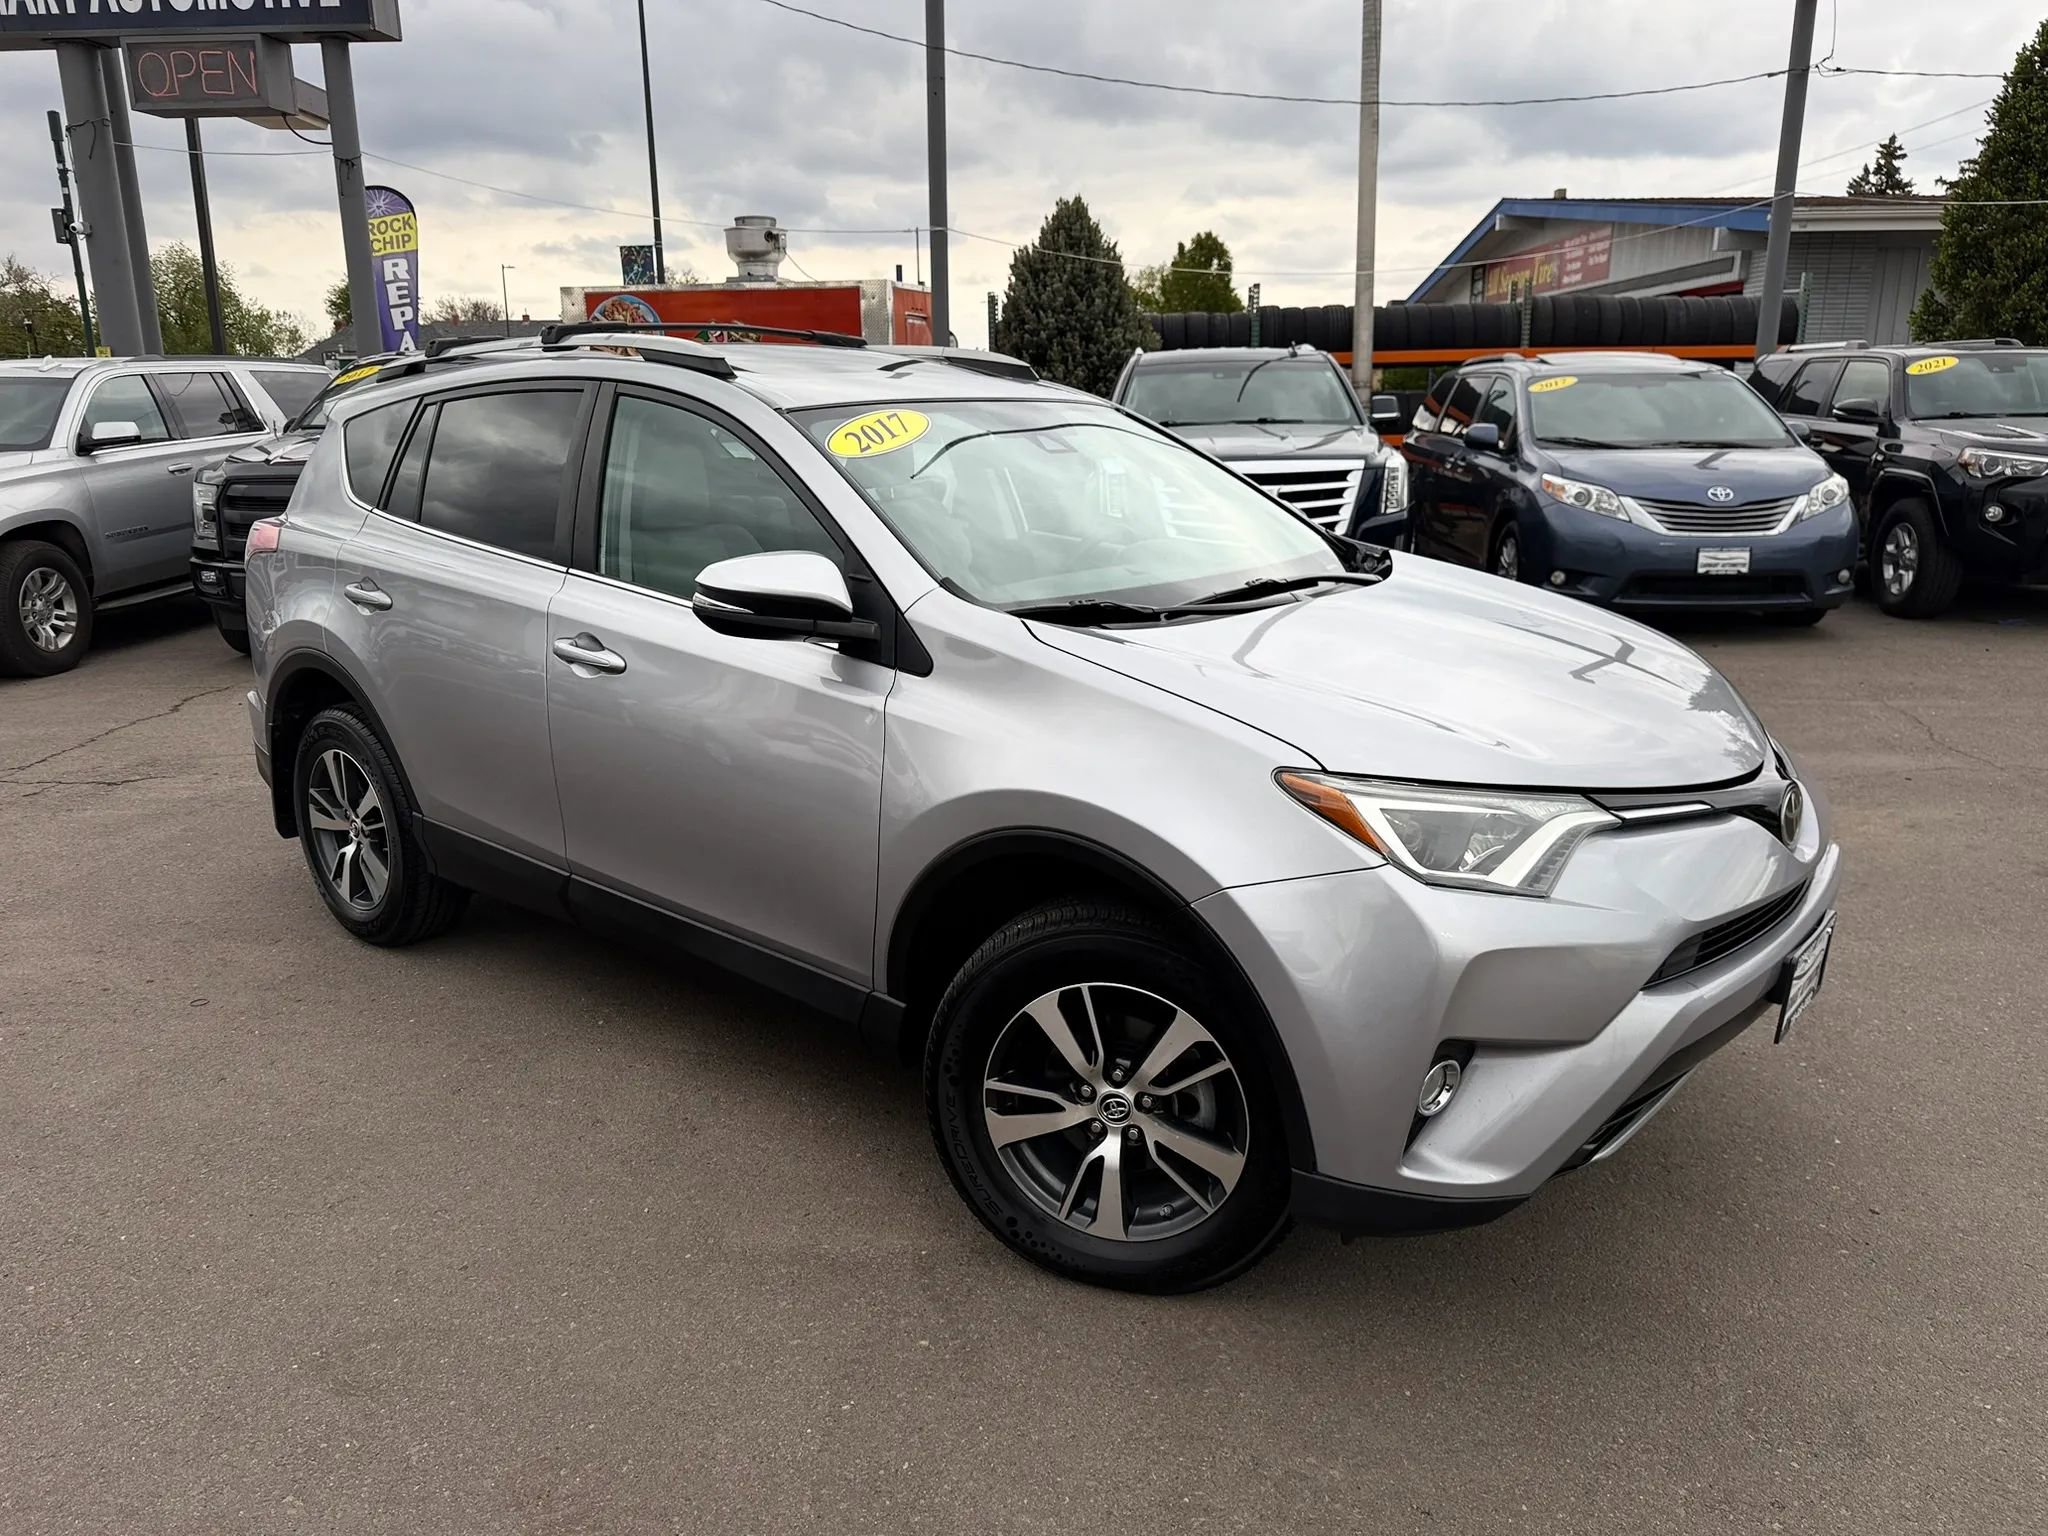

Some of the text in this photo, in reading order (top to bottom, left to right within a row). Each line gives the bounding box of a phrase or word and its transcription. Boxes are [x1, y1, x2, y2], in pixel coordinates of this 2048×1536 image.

[138, 49, 257, 97] OPEN
[368, 215, 414, 236] ROCK
[371, 233, 412, 253] CHIP
[1917, 358, 1947, 373] 2021
[844, 413, 909, 453] 2017
